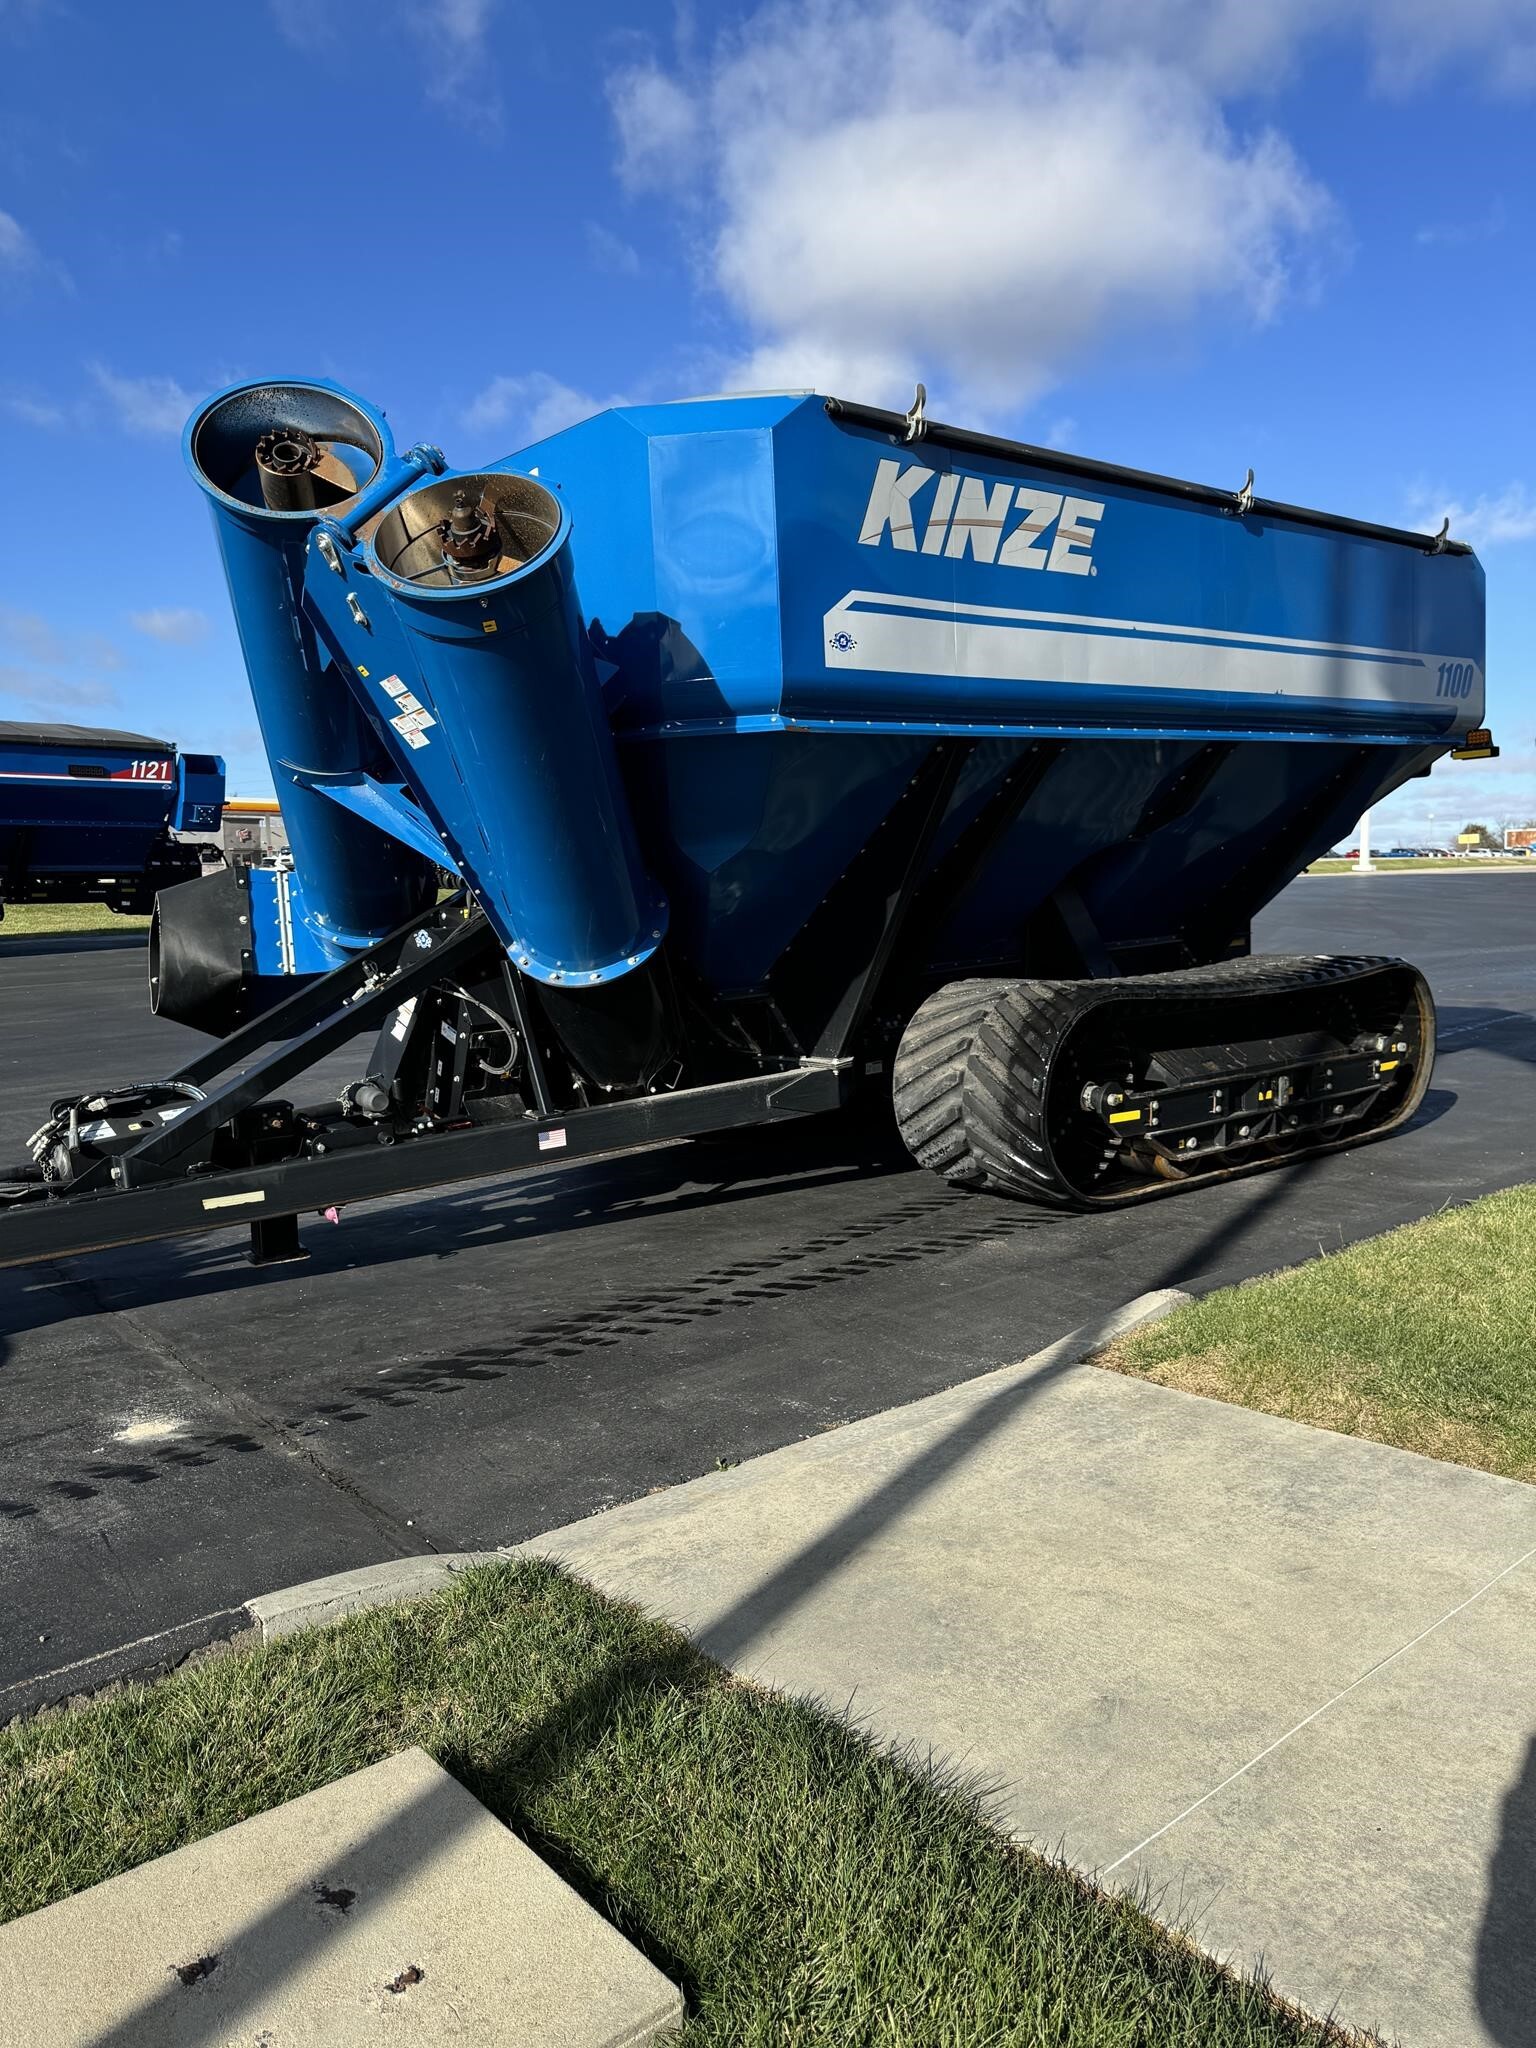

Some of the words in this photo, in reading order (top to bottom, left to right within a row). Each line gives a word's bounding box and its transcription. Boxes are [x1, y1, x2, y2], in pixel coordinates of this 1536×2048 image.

[857, 457, 1106, 577] KINZE
[1436, 662, 1474, 699] 1100
[131, 760, 168, 779] 1121
